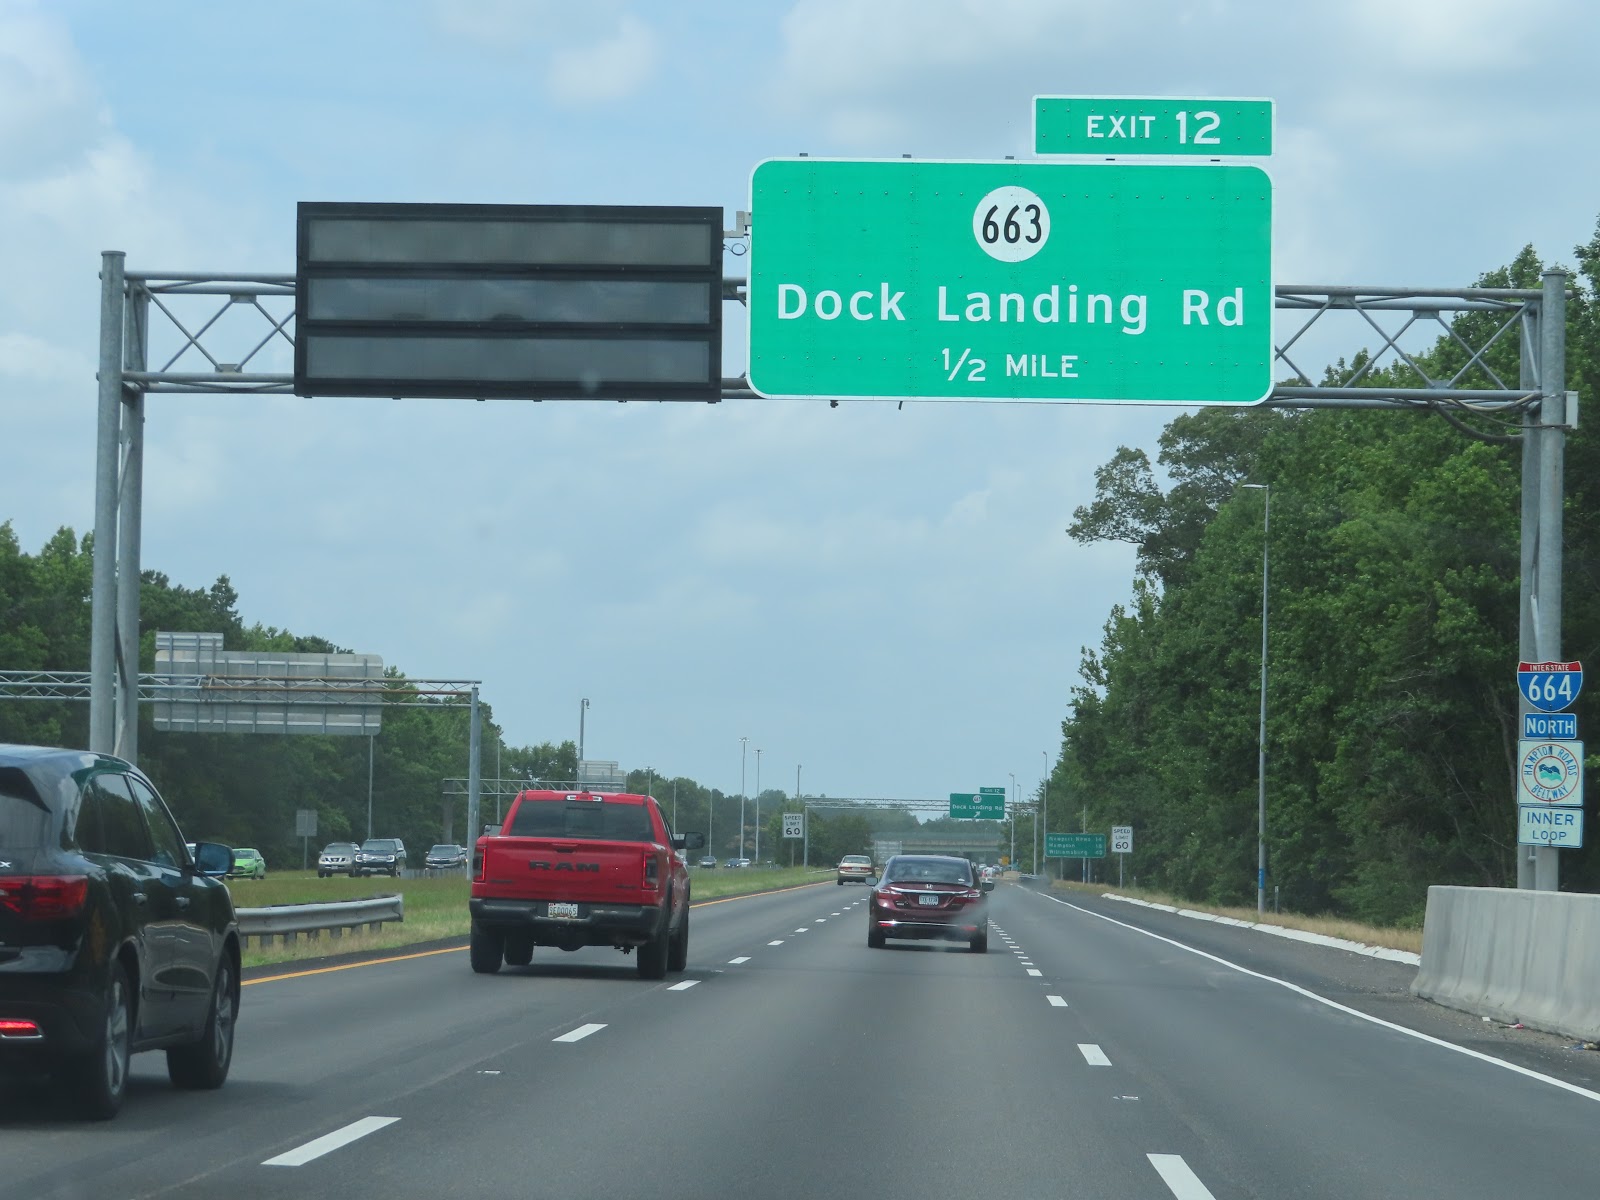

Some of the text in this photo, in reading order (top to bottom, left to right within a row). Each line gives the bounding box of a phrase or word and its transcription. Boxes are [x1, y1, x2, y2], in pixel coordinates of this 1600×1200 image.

[1087, 111, 1221, 145] EXIT 12
[982, 204, 1042, 244] 663
[777, 282, 1244, 335] Dock Landing Rd
[1006, 353, 1079, 378] MILE
[1529, 664, 1570, 672] INTERSTATE
[1528, 674, 1572, 702] 664
[1526, 717, 1574, 735] NORTH
[1523, 745, 1578, 776] HAMPTON ROADS
[1531, 784, 1569, 800] BELTWAY
[968, 804, 993, 812] Landing
[1526, 812, 1575, 826] INNER
[785, 827, 801, 836] 60
[1532, 829, 1567, 841] LOOP
[1115, 841, 1129, 850] 60
[528, 860, 599, 873] RAM
